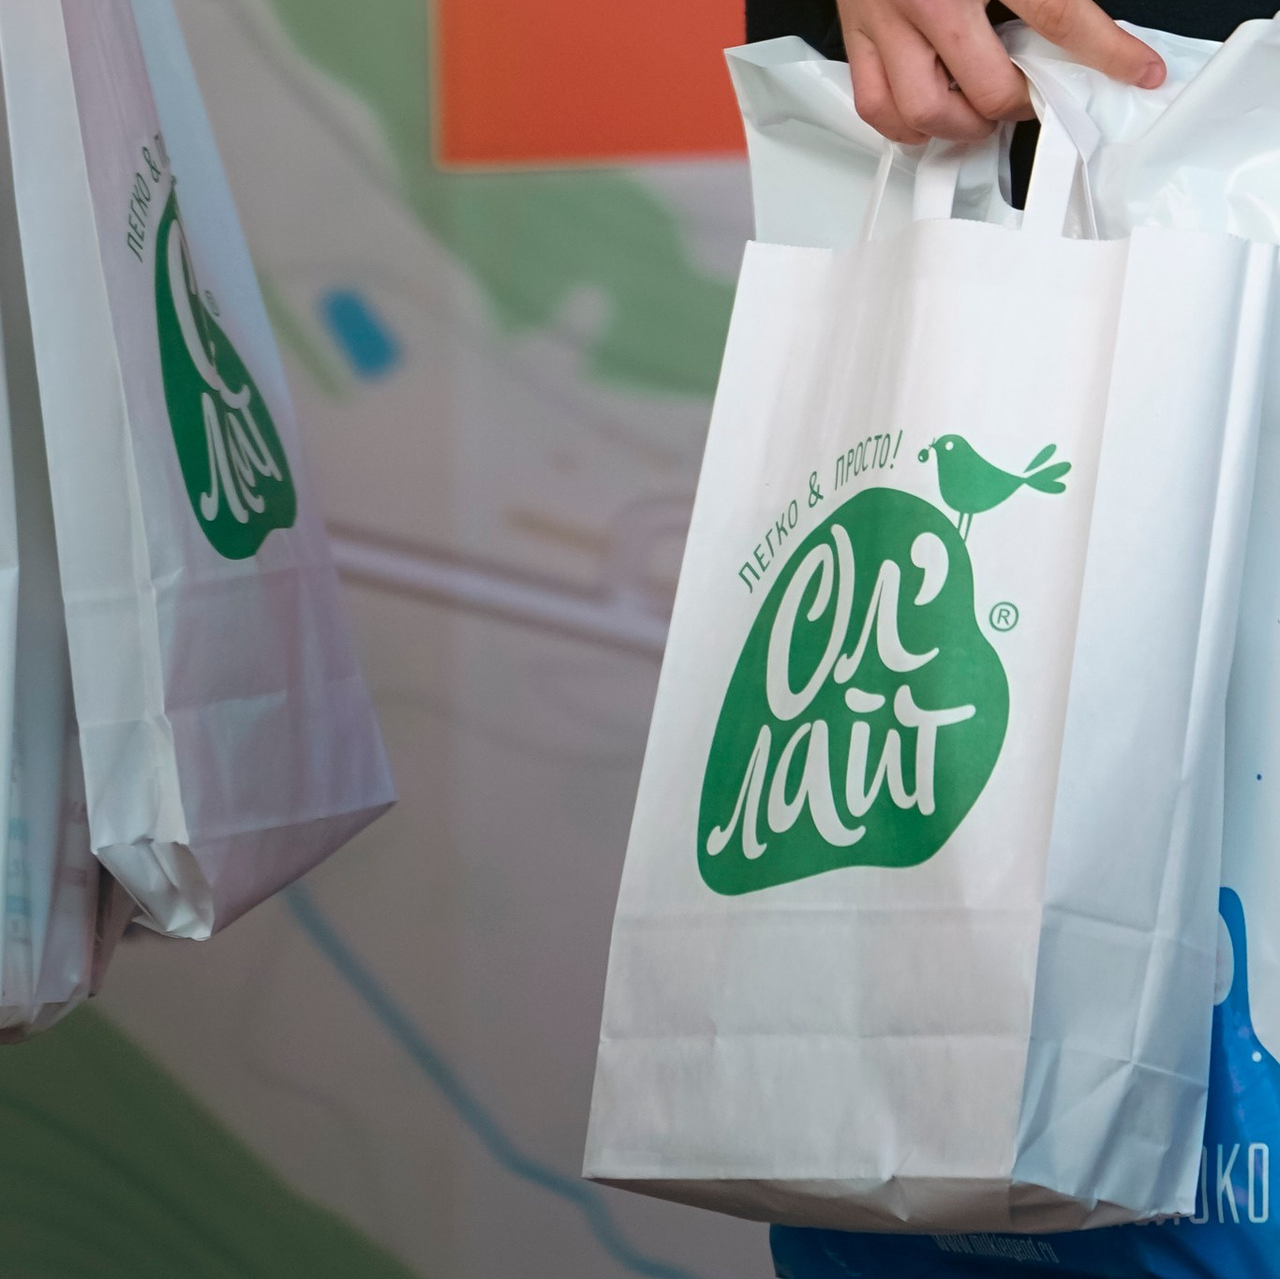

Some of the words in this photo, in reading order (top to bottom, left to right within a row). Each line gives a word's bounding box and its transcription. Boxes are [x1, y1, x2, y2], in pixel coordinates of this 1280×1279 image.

[738, 499, 798, 594] ЛЕГКО
[808, 471, 824, 508] &
[835, 429, 903, 491] ПРОСТО!
[706, 684, 976, 860] лайт
